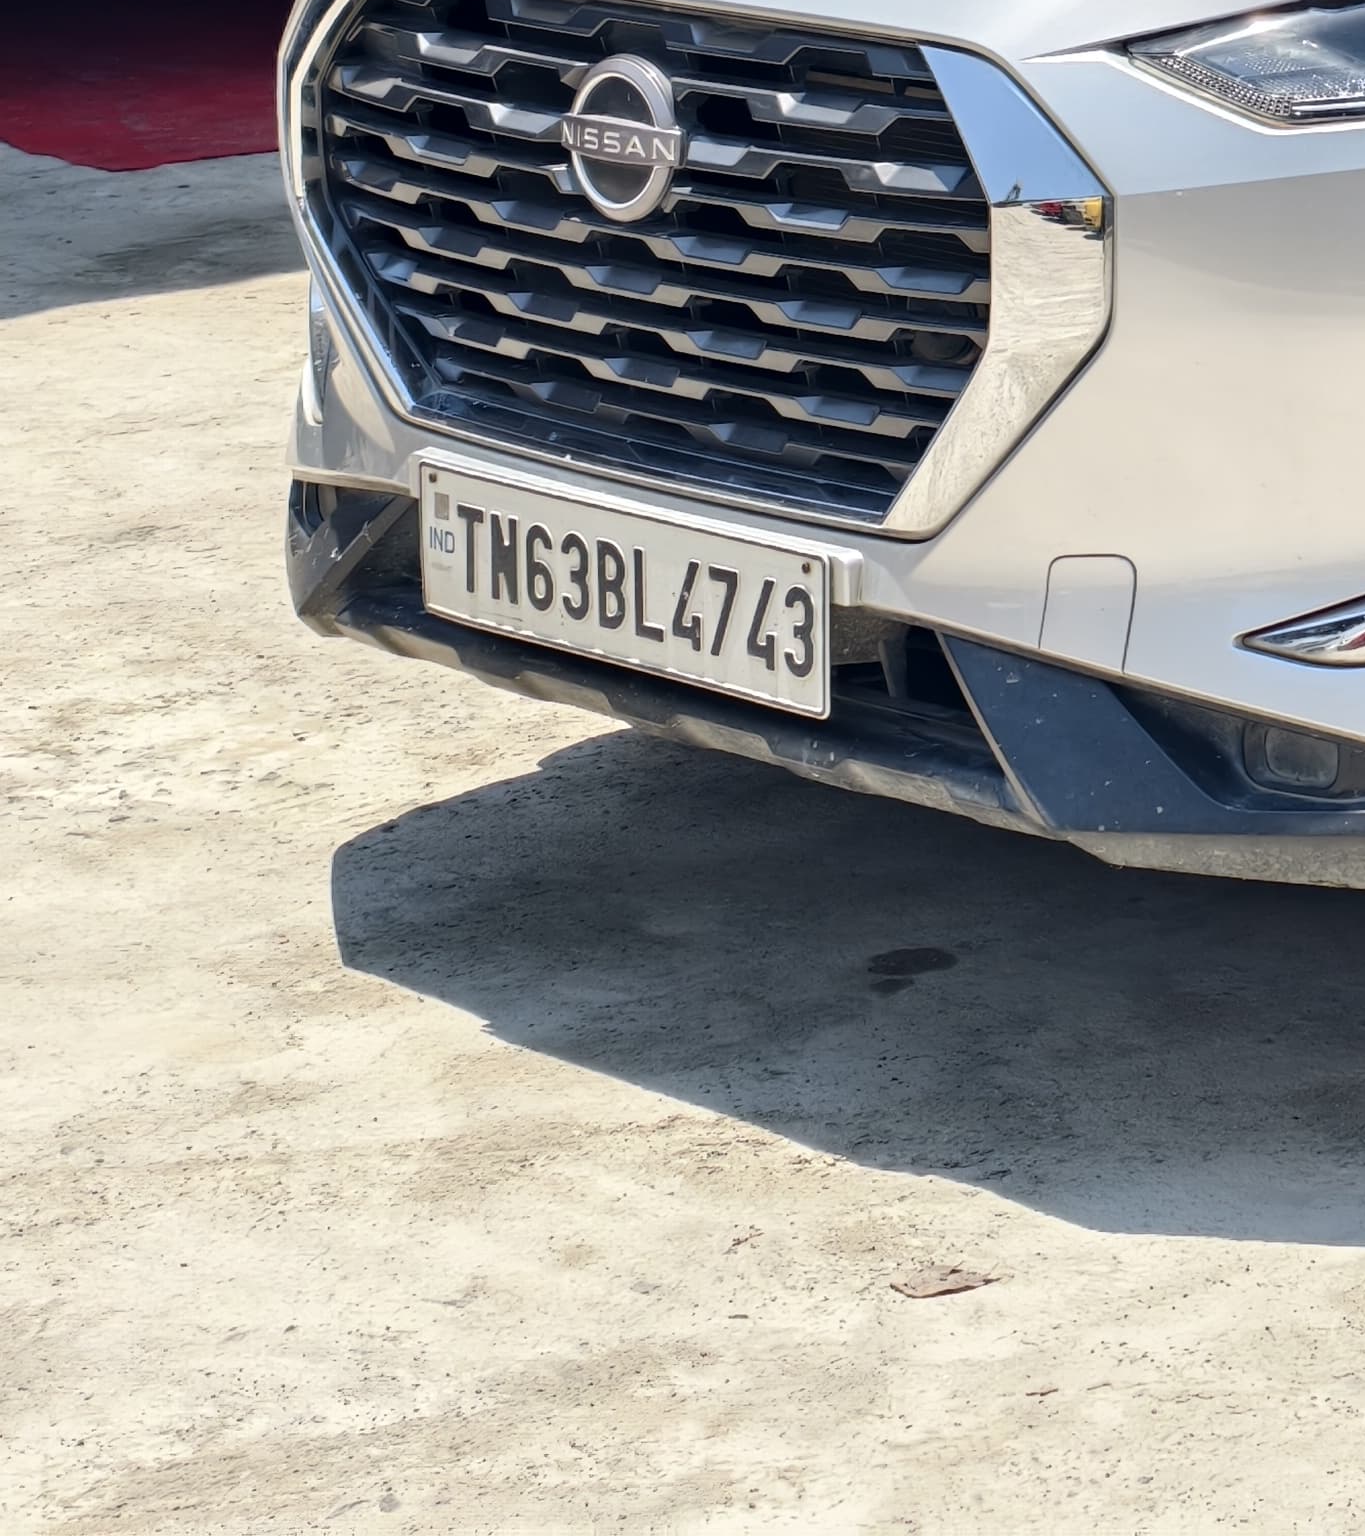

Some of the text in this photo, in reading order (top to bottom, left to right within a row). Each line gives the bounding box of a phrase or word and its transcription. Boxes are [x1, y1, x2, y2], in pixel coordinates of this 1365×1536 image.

[561, 120, 675, 161] NISSAN
[429, 524, 455, 555] IND
[457, 503, 815, 678] TN63BL4743
